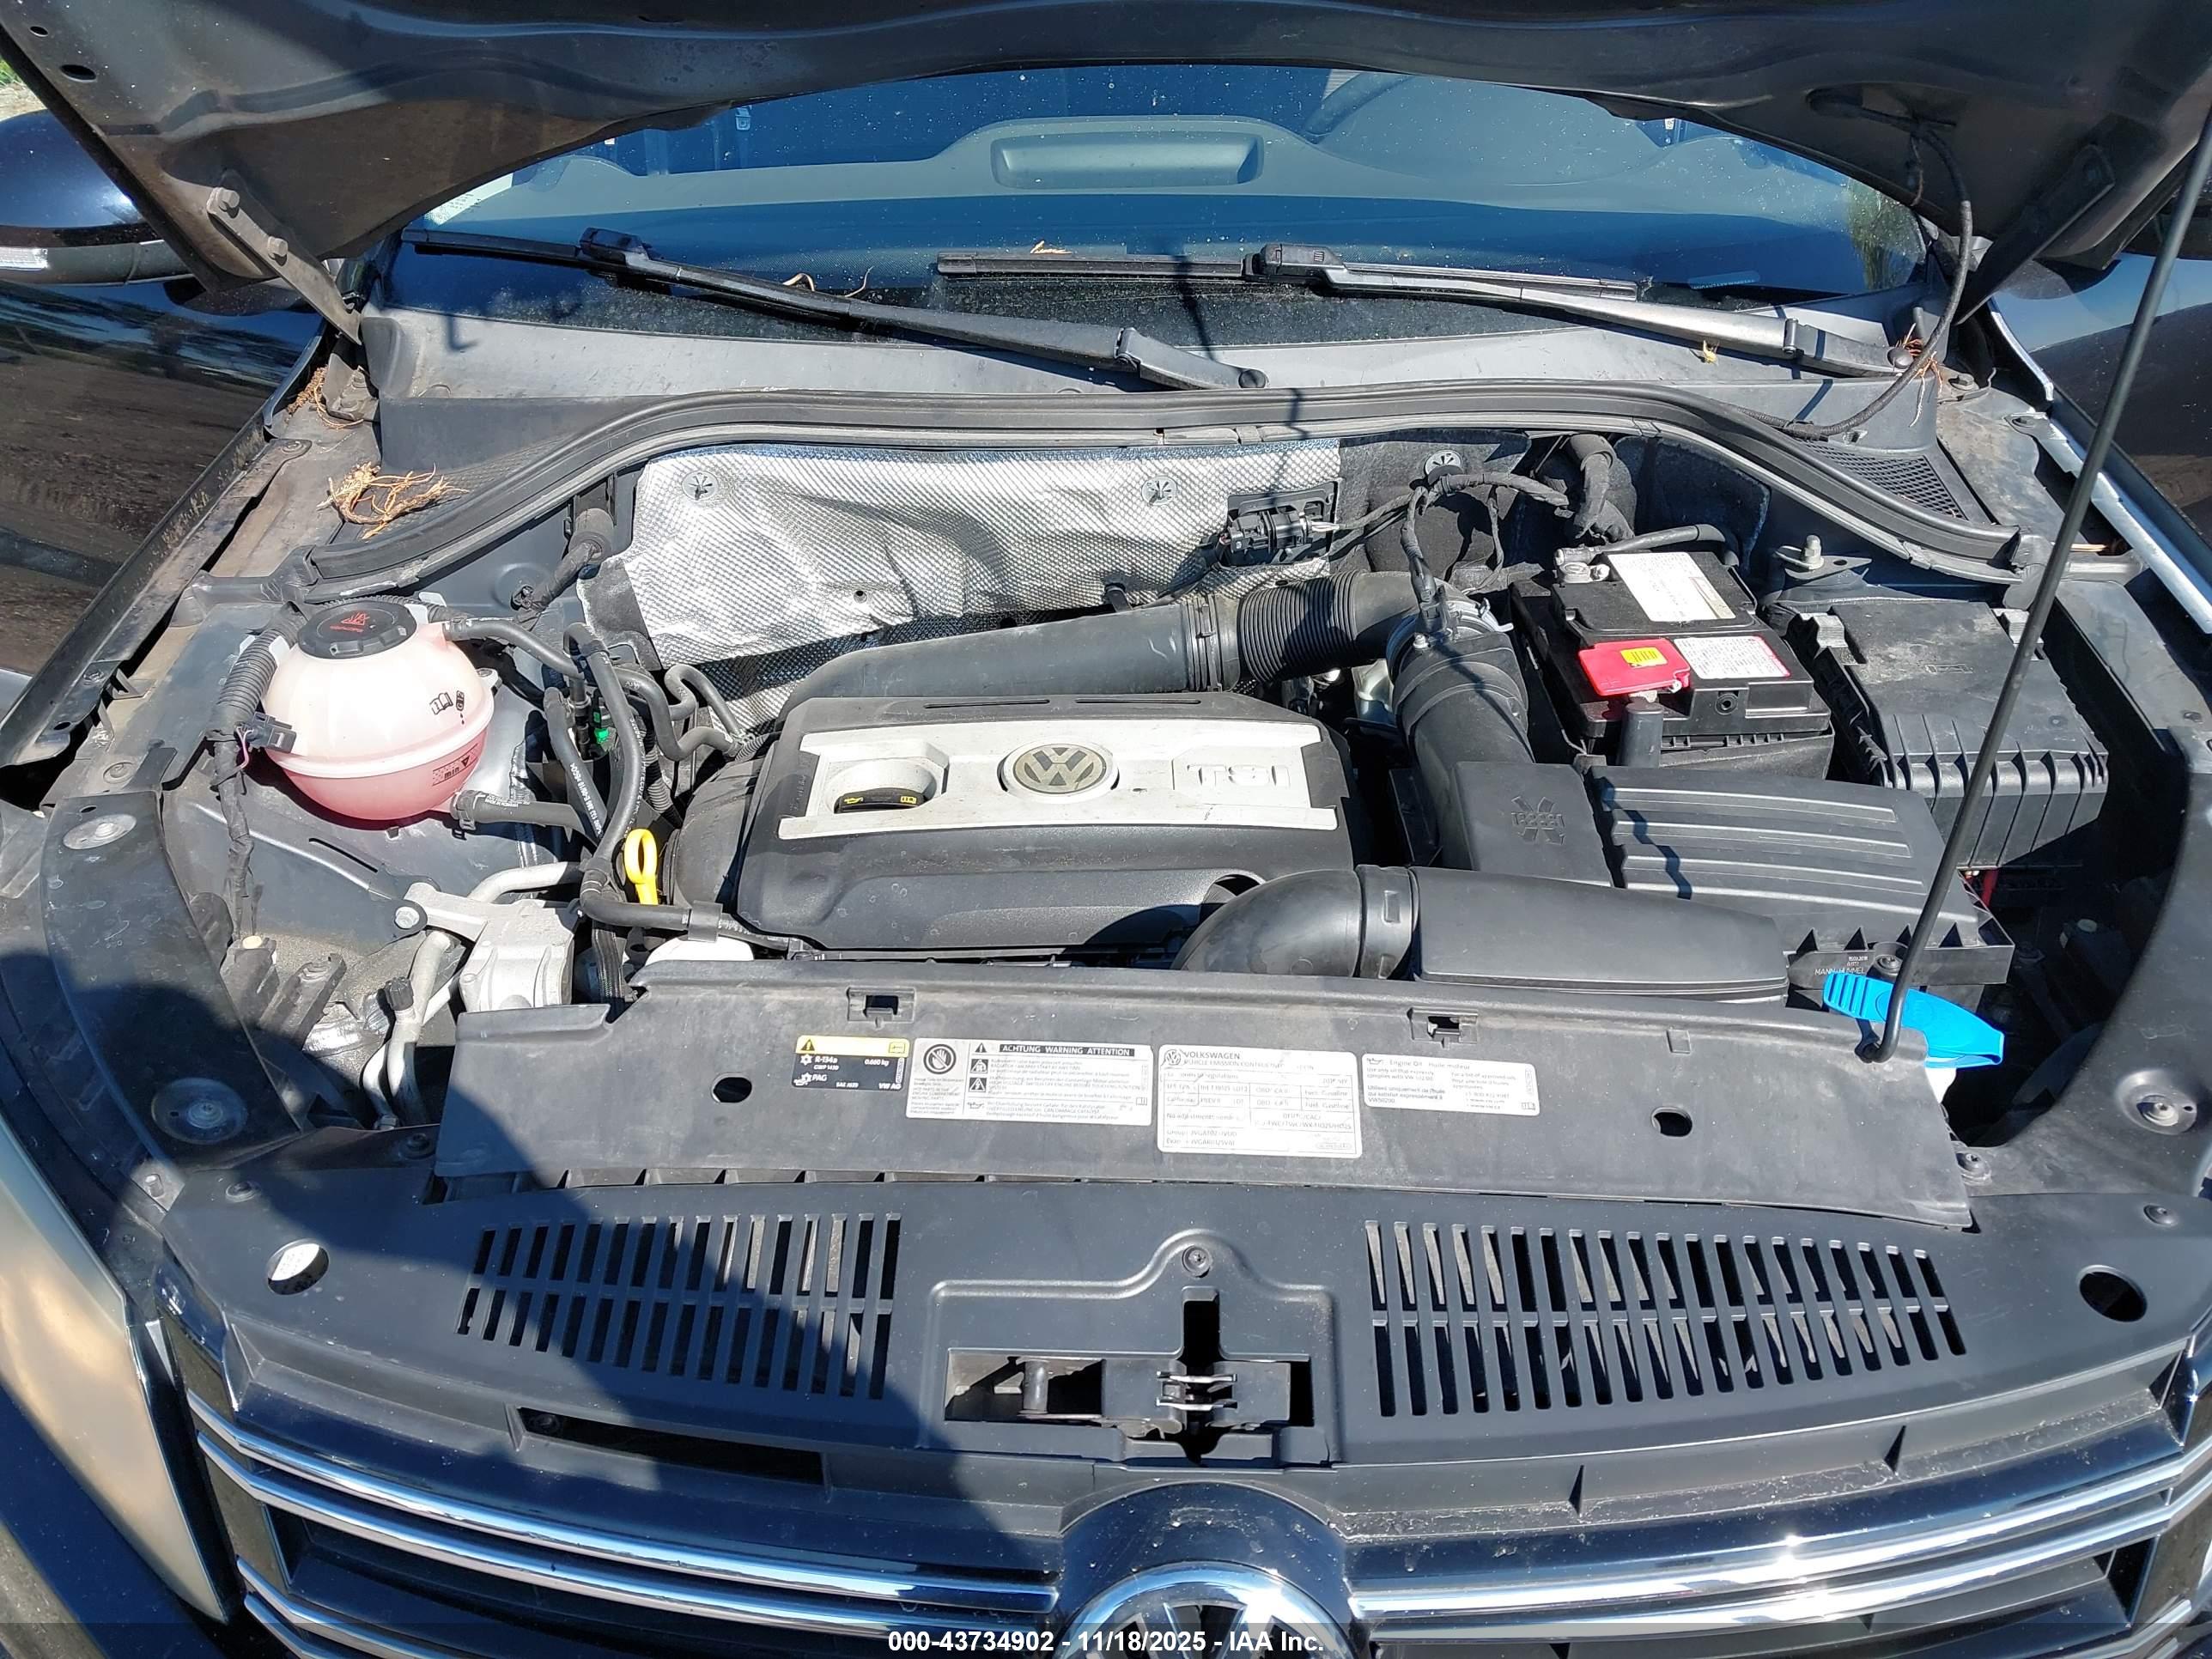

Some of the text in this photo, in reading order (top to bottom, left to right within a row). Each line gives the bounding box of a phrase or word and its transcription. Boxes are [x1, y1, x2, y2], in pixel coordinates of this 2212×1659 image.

[444, 766, 459, 779] min
[1002, 1044, 1041, 1053] ACHTUNG
[1044, 1046, 1083, 1054] WARNING
[1086, 1047, 1131, 1056] ATTENTION
[1185, 1050, 1241, 1060] VOLKSWAGEN
[811, 1073, 828, 1082] PAG
